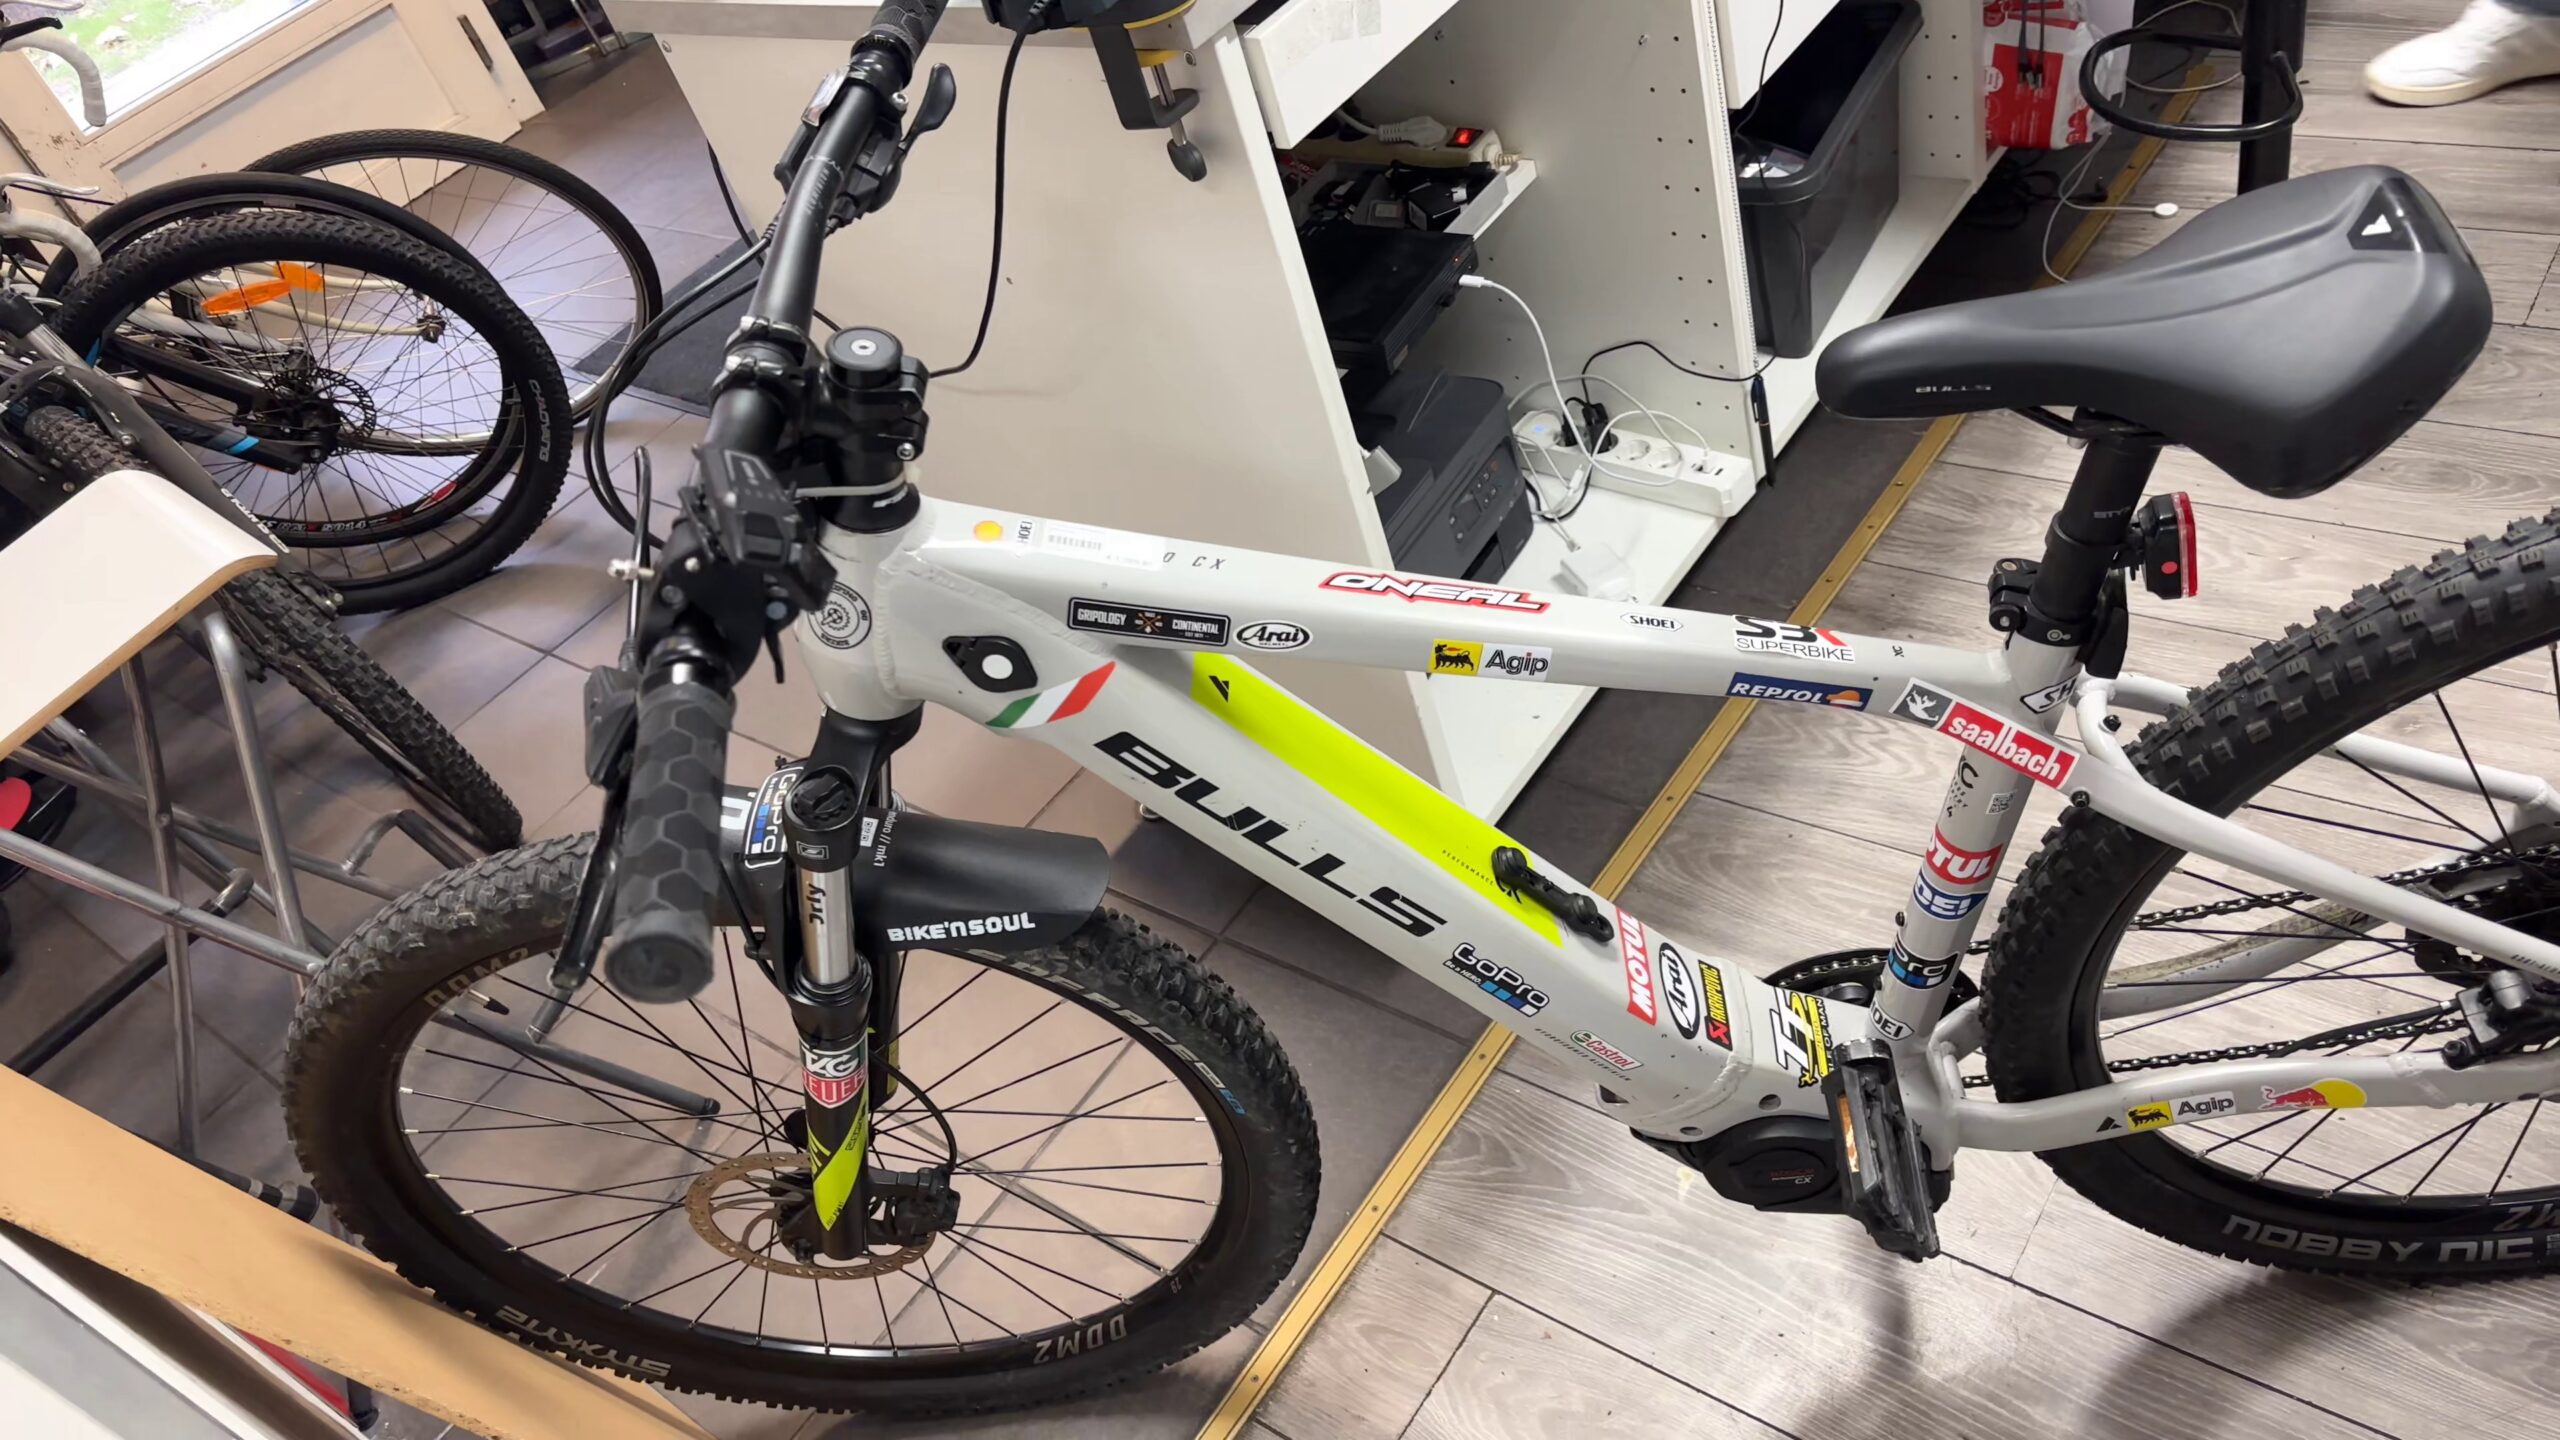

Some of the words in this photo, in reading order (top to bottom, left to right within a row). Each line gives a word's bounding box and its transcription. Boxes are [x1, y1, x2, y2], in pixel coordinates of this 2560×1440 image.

[1077, 607, 1127, 627] GRIPOLOGY
[1172, 618, 1219, 635] CONTINENTAL
[1244, 623, 1301, 645] Arai
[1629, 614, 1676, 630] SHOEI
[1485, 649, 1549, 676] Agip
[1736, 637, 1854, 662] SUPERBIKE
[1731, 682, 1823, 705] REPSOL
[1947, 716, 2062, 781] saalbach
[1093, 731, 1448, 938] BULLS
[1441, 850, 1494, 886] PERFORMANCE
[1453, 942, 1550, 1009] GoPro
[1620, 909, 1654, 1019] MOTUL
[1661, 950, 1694, 1032] Arai
[1584, 1039, 1635, 1068] Castrol
[2177, 1096, 2235, 1116] Agip
[2220, 1214, 2424, 1263] NOBBY
[2437, 1236, 2535, 1264] NIC
[1033, 1313, 1128, 1365] DDM2
